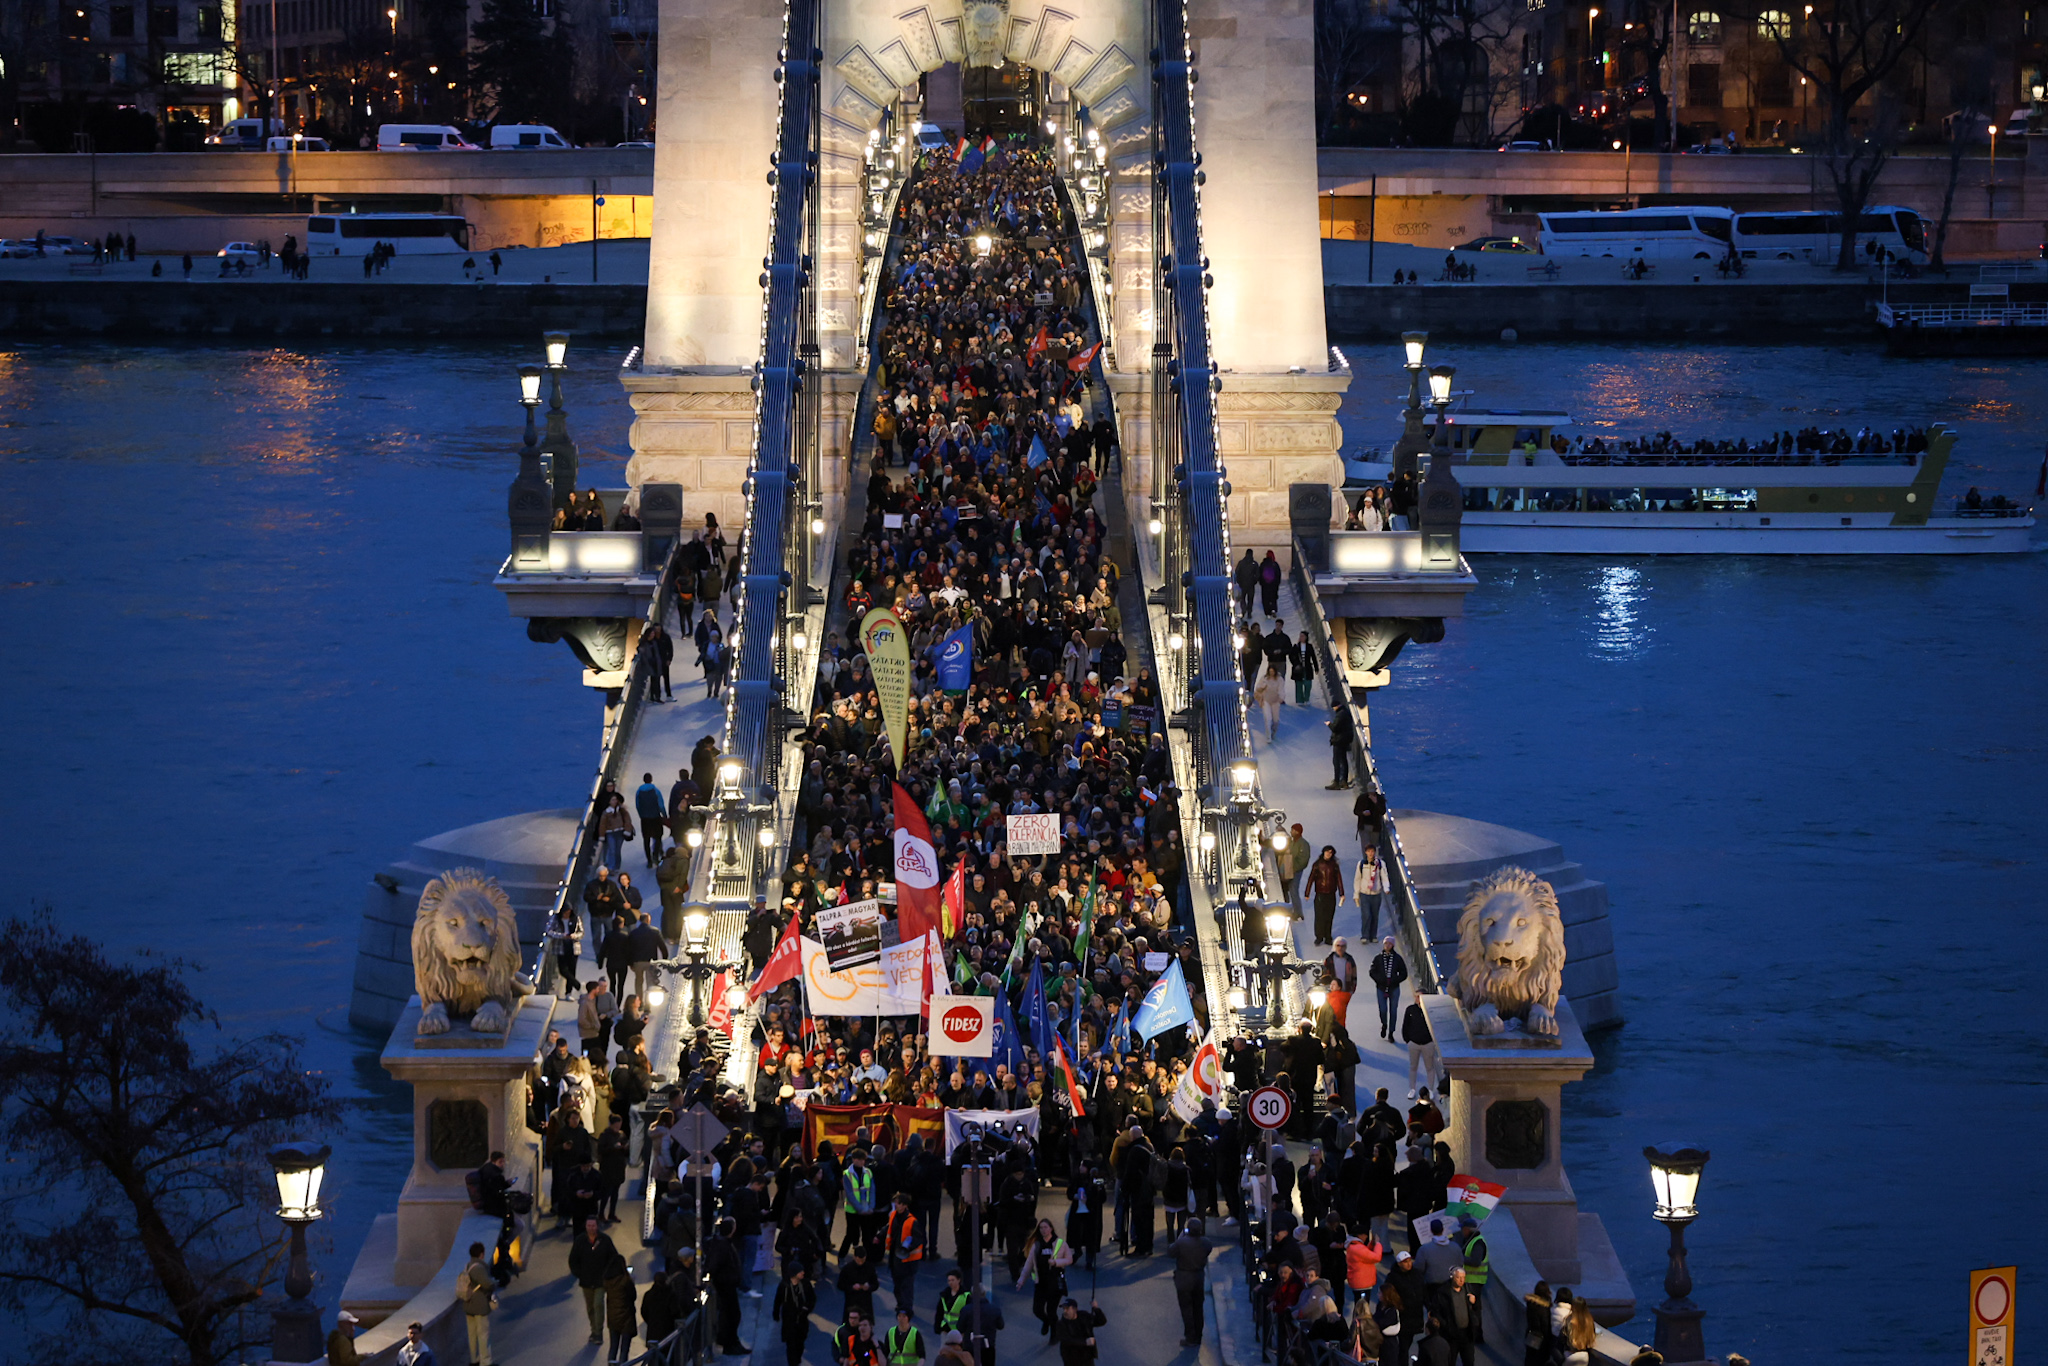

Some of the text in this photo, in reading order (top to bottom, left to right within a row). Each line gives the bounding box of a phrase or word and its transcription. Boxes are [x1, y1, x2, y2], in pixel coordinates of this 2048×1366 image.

[1014, 814, 1050, 828] ZERO
[1009, 828, 1058, 842] TOLERANCIA
[819, 912, 842, 922] TALPRA
[848, 904, 876, 915] MAGYAR
[890, 963, 946, 986] VÉDK
[944, 1017, 980, 1031] FIDESZ
[1259, 1099, 1279, 1116] 30
